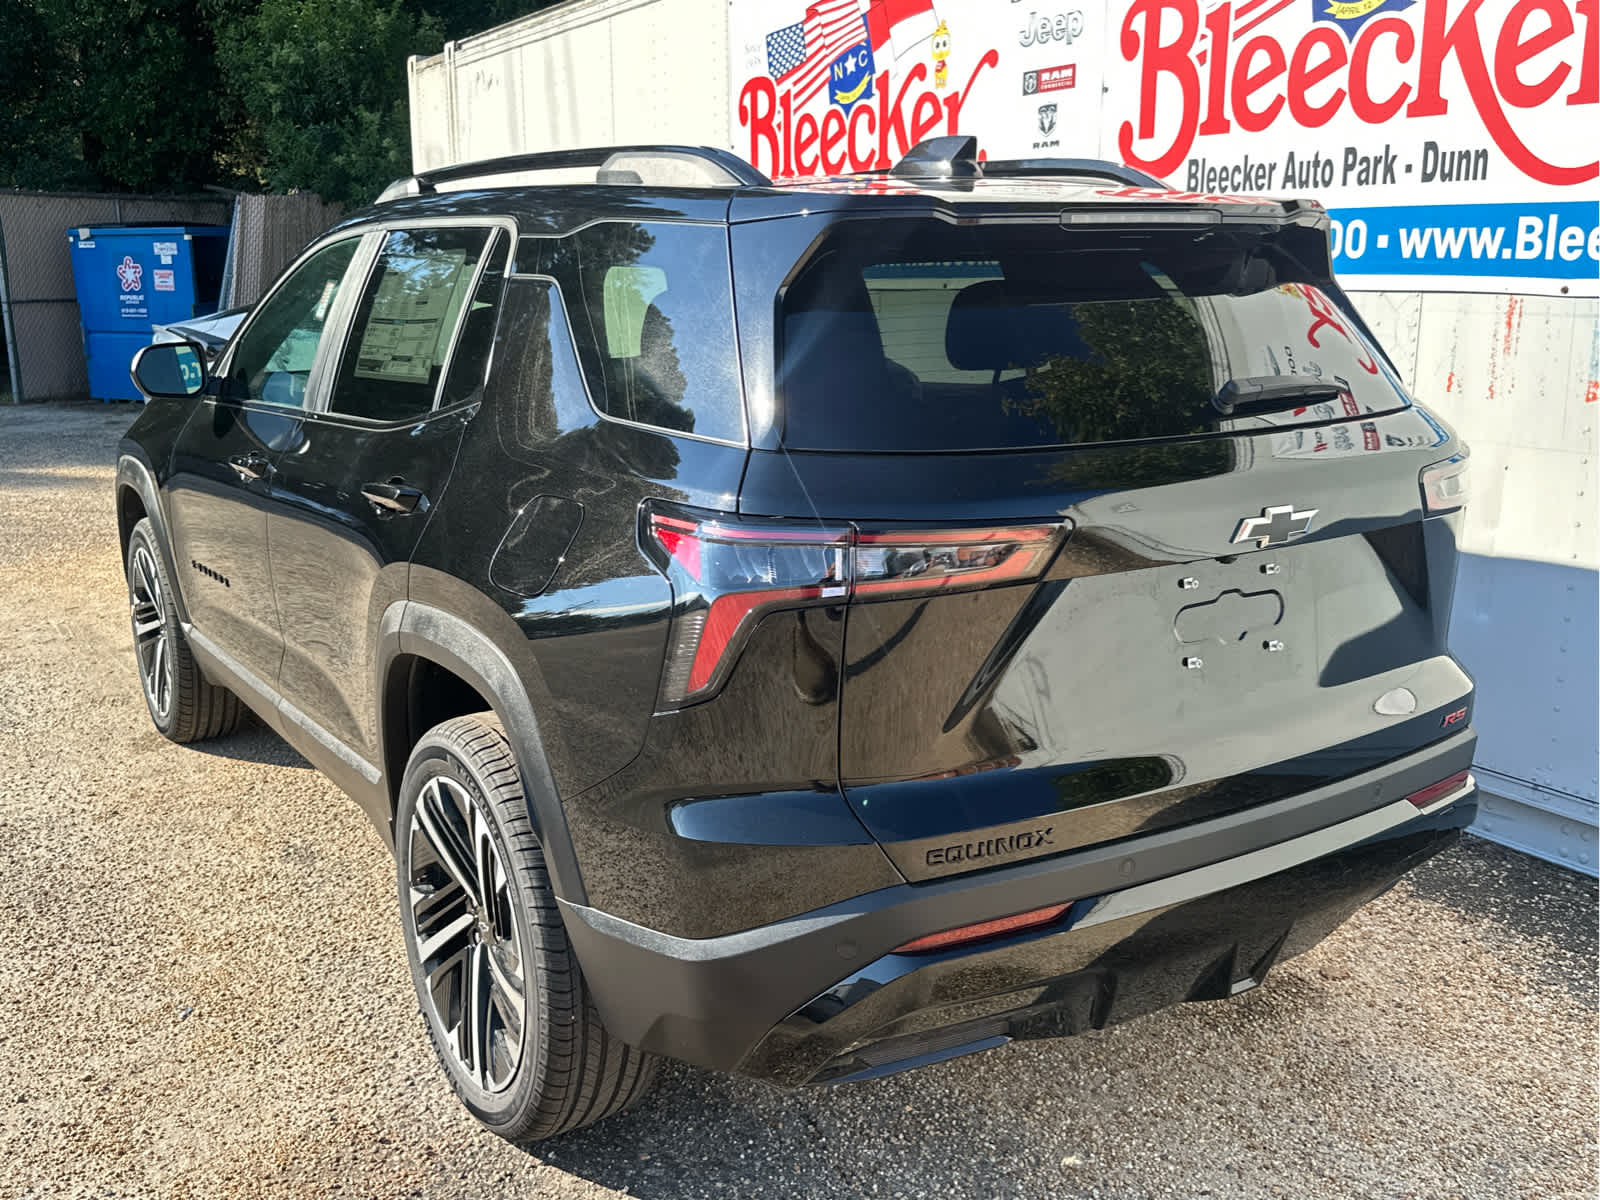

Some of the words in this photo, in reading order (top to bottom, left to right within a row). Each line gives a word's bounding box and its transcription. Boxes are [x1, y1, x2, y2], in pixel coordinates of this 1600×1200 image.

[1018, 10, 1084, 48] Jeep
[1040, 69, 1073, 82] RAM
[738, 49, 999, 178] Bleecker
[1032, 139, 1061, 150] RAM
[1186, 154, 1278, 194] Bleecker
[1282, 150, 1335, 190] Auto
[1342, 144, 1397, 187] Park
[1421, 141, 1489, 184] Dunn
[1440, 705, 1468, 728] RS
[926, 827, 1055, 866] EQUINOX
